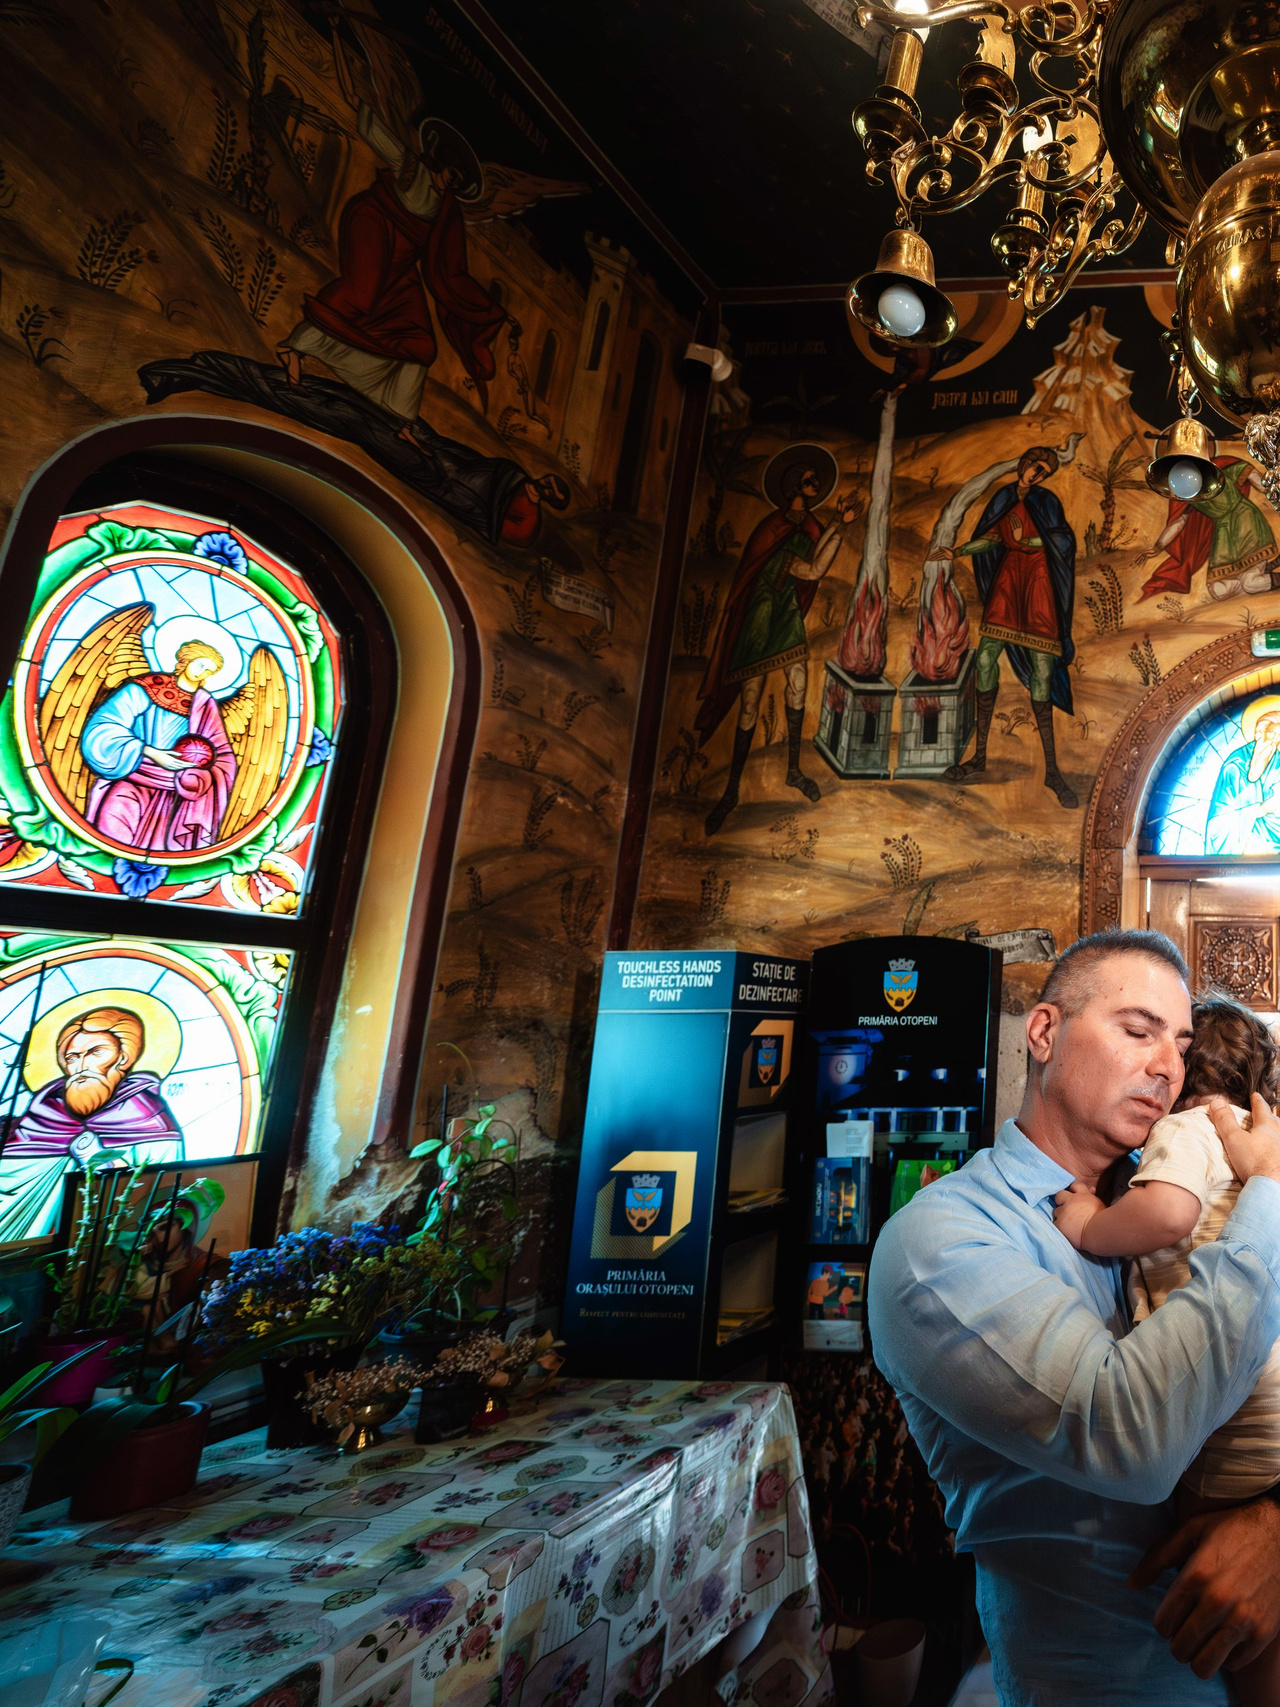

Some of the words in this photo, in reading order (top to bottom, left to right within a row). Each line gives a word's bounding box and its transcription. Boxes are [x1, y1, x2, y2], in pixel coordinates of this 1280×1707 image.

[971, 391, 989, 406] LUI
[992, 389, 1018, 405] CAIN
[617, 960, 681, 974] TOUCHLESS
[682, 959, 722, 974] HANDS
[783, 965, 796, 981] DE
[621, 974, 714, 989] DESINFECTATION
[649, 988, 683, 1003] POINT
[738, 985, 803, 1003] DEZINFECTARE
[858, 1014, 899, 1026] PRIMĂRIA
[899, 1015, 938, 1026] OTOPENI
[606, 1268, 667, 1282] PRIMĂRIA
[638, 1283, 694, 1296] OTOPENI
